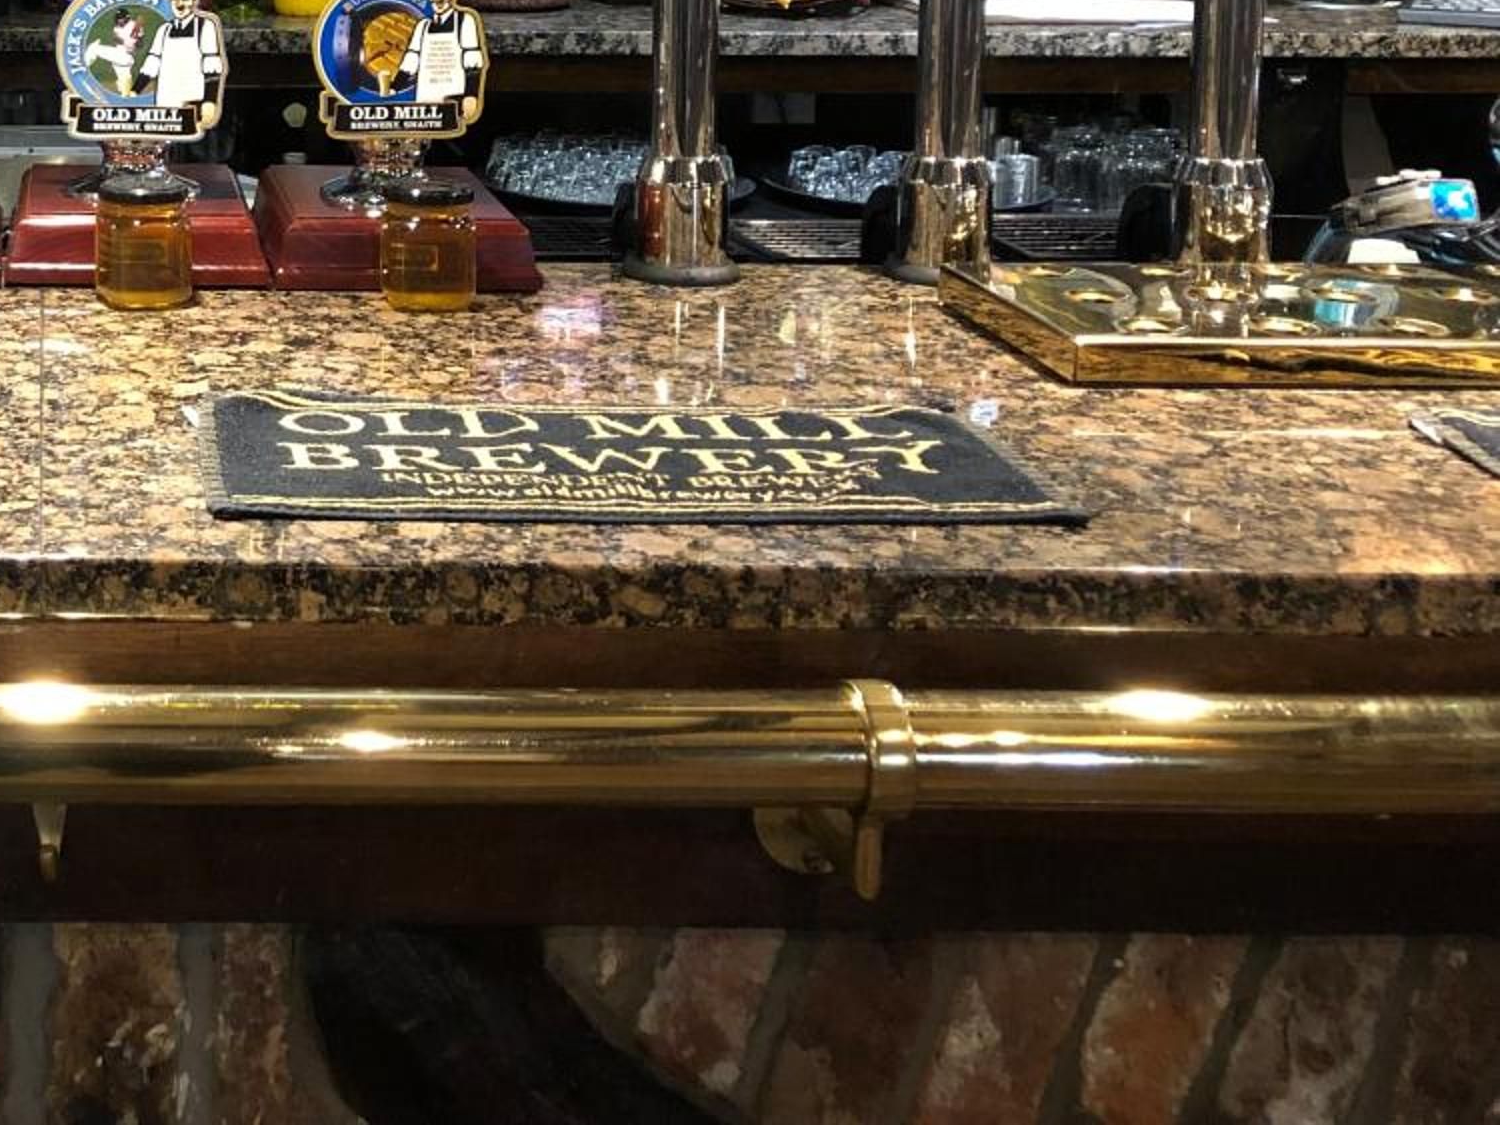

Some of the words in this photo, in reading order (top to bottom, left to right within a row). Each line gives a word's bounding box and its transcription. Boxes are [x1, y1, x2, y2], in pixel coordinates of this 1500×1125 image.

[66, 18, 88, 75] JACK'S
[92, 108, 131, 122] OLD
[135, 108, 183, 122] MILL
[351, 106, 389, 120] OLD
[394, 106, 443, 120] MILL
[279, 408, 542, 439] OLD
[572, 413, 914, 441] MILL
[276, 439, 945, 475] BREWERY
[380, 472, 672, 489] INDEPENDENT
